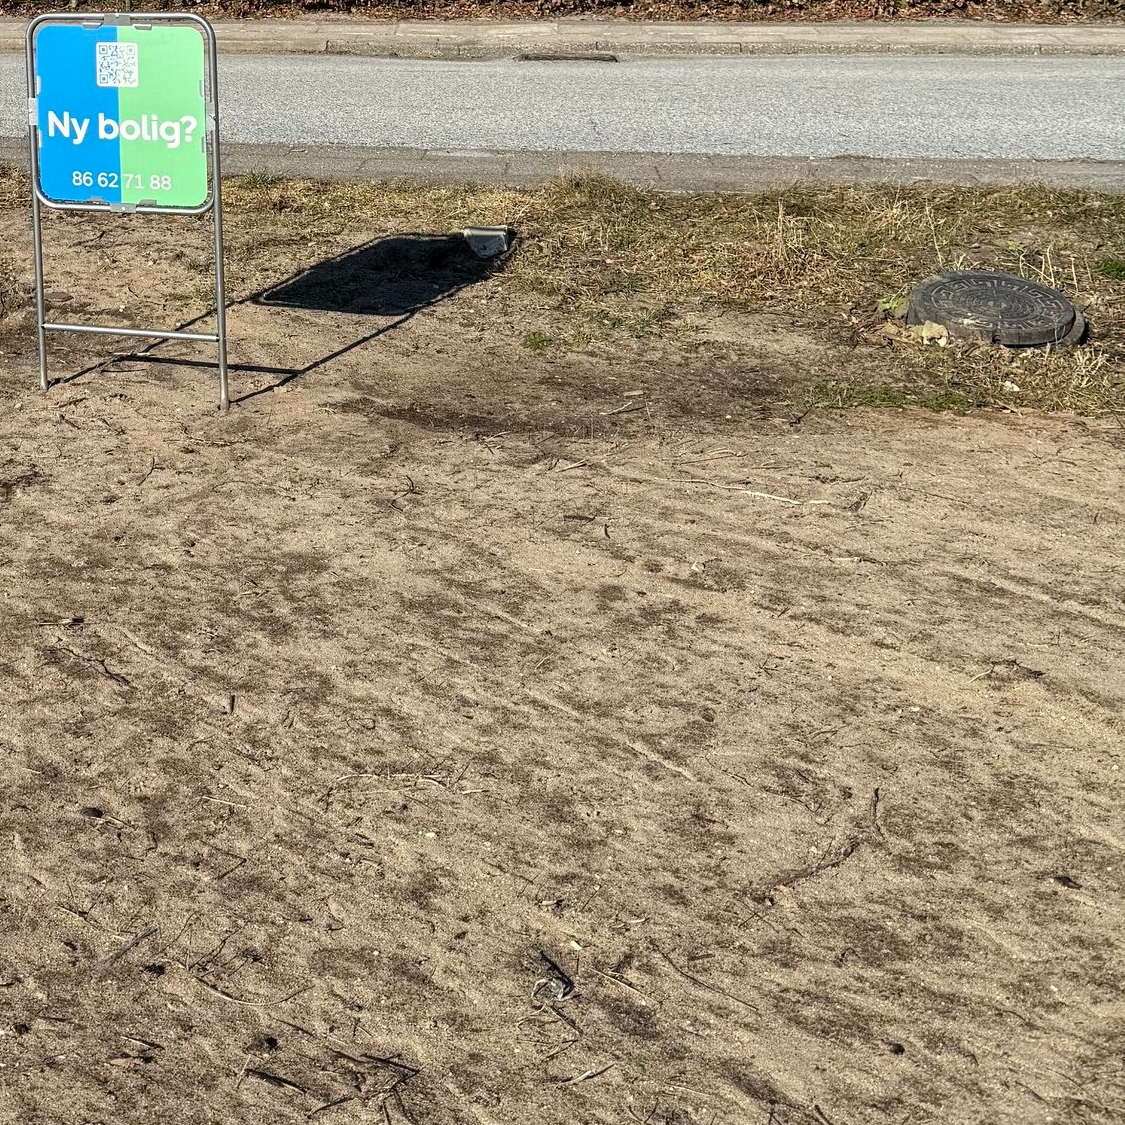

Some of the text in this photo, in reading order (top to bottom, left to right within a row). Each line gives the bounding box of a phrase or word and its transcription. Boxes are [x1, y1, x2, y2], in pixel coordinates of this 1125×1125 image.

[47, 110, 198, 149] Ny bolig?
[72, 170, 172, 191] 86 62 71 88
